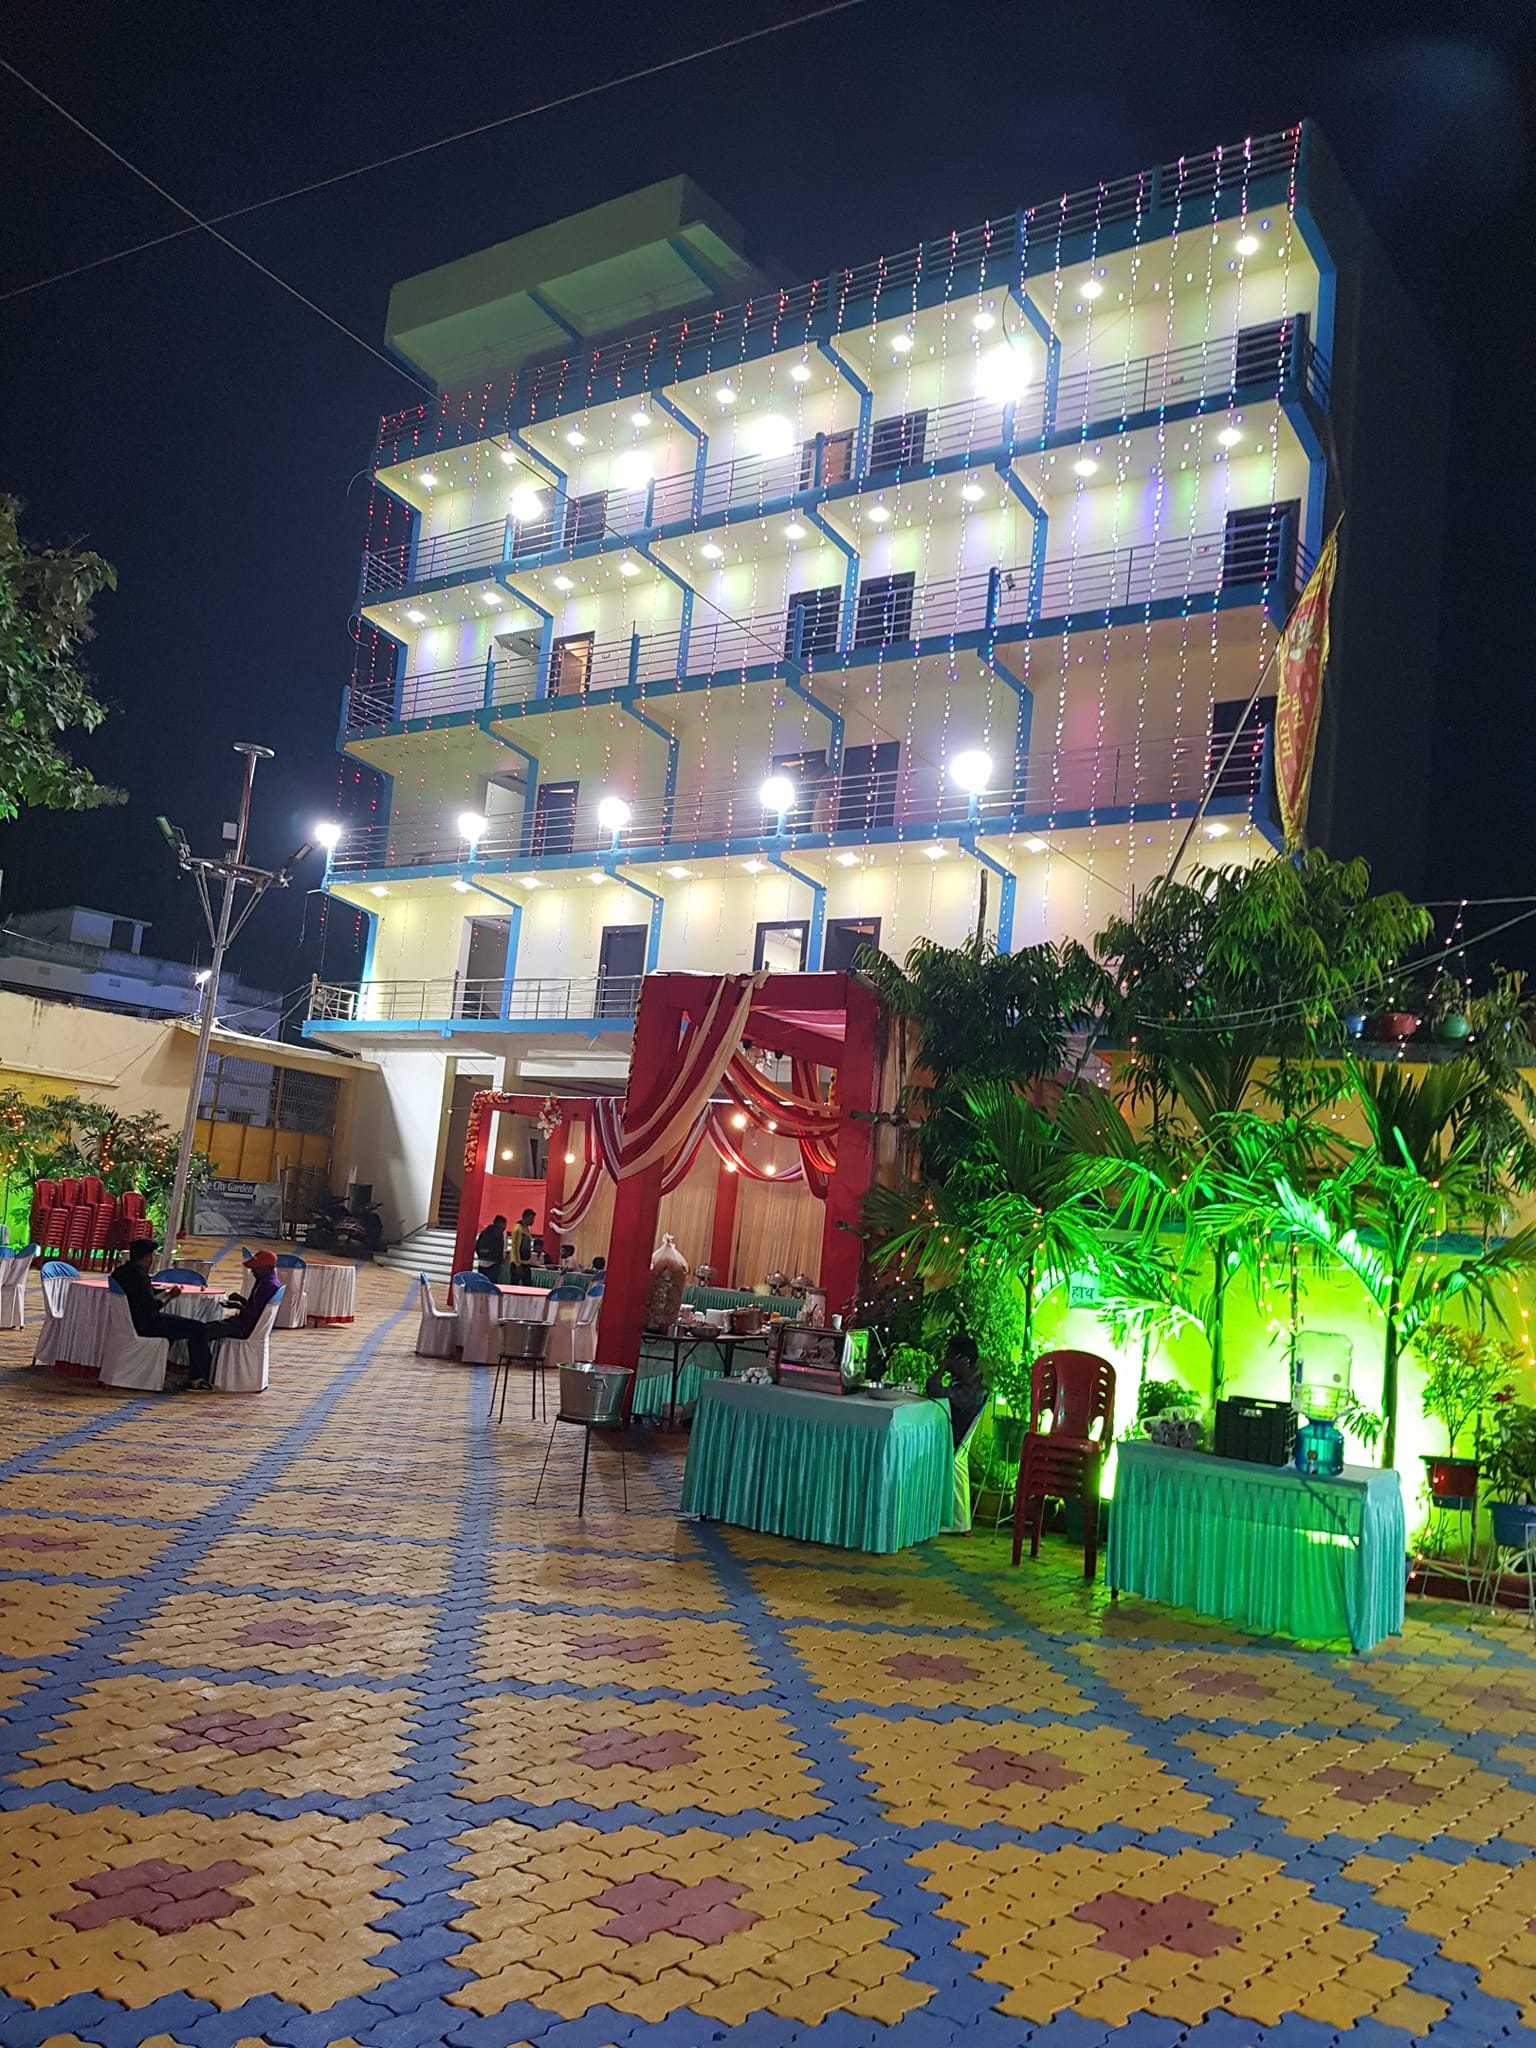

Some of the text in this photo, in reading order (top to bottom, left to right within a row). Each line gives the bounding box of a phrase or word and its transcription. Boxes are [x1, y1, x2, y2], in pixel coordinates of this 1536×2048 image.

[1292, 691, 1305, 730] जय
[1280, 717, 1292, 758] राम
[213, 1181, 228, 1191] City
[227, 1182, 254, 1194] Garden
